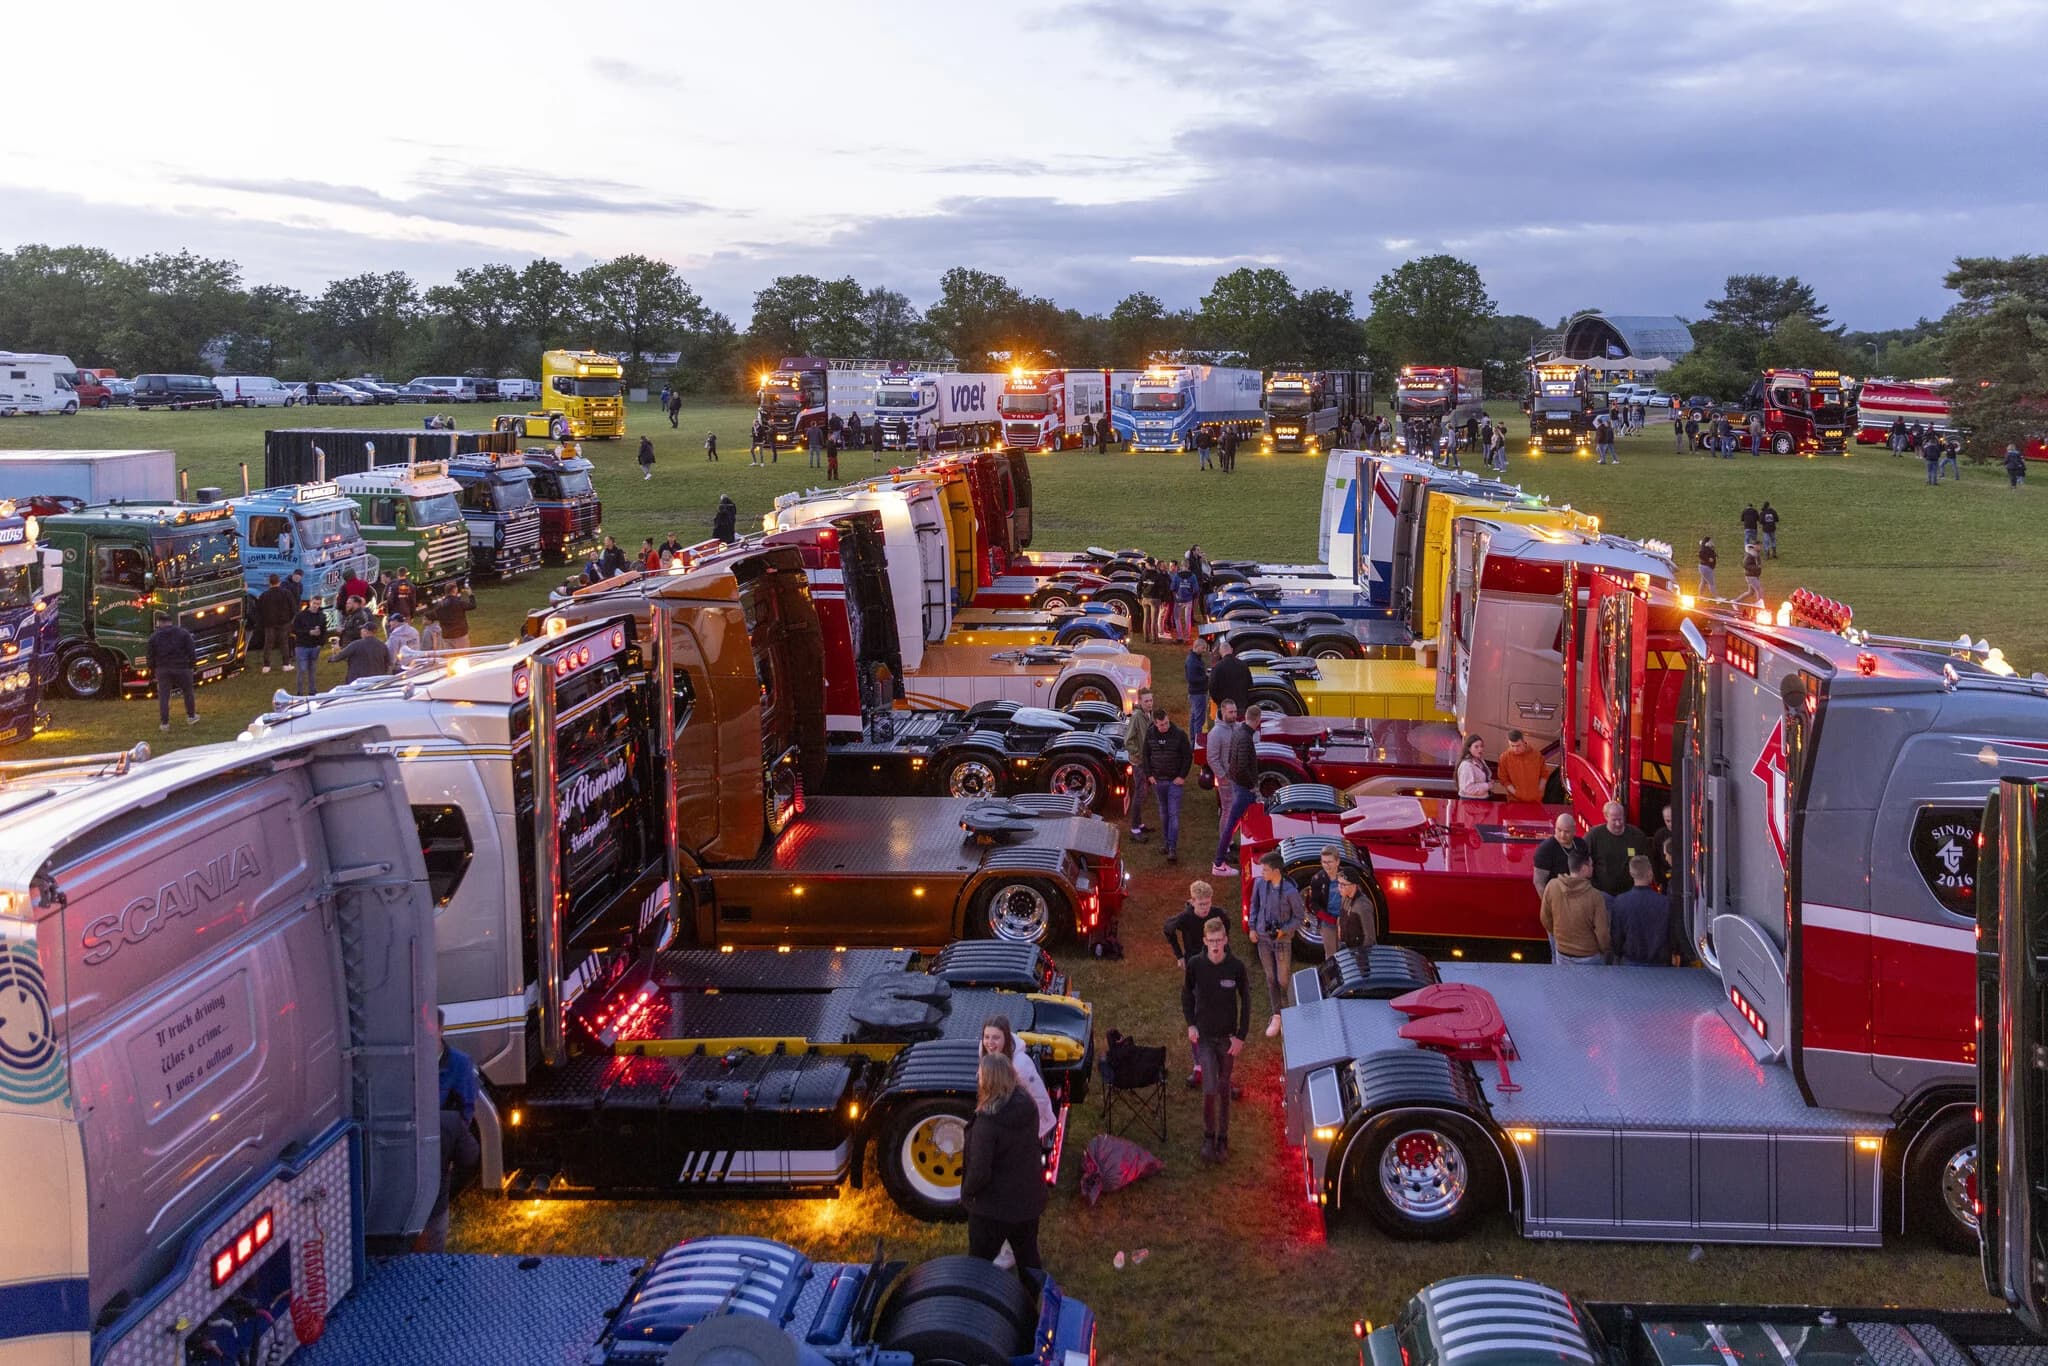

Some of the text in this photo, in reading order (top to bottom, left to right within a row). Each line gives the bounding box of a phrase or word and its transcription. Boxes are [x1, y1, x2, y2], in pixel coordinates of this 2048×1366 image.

[951, 382, 986, 412] voet
[302, 486, 336, 499] PARKER
[248, 553, 298, 565] JOHN PARKER
[327, 571, 340, 585] TIR
[1931, 824, 1974, 840] SINDS
[1935, 873, 1974, 888] 2016
[82, 843, 262, 966] SCANIA
[168, 1014, 193, 1039] truck
[195, 994, 226, 1022] driving
[162, 1049, 186, 1074] Was
[188, 1043, 195, 1058] a
[176, 1071, 195, 1092] was
[197, 1065, 204, 1078] a
[206, 1043, 234, 1070] outlaw
